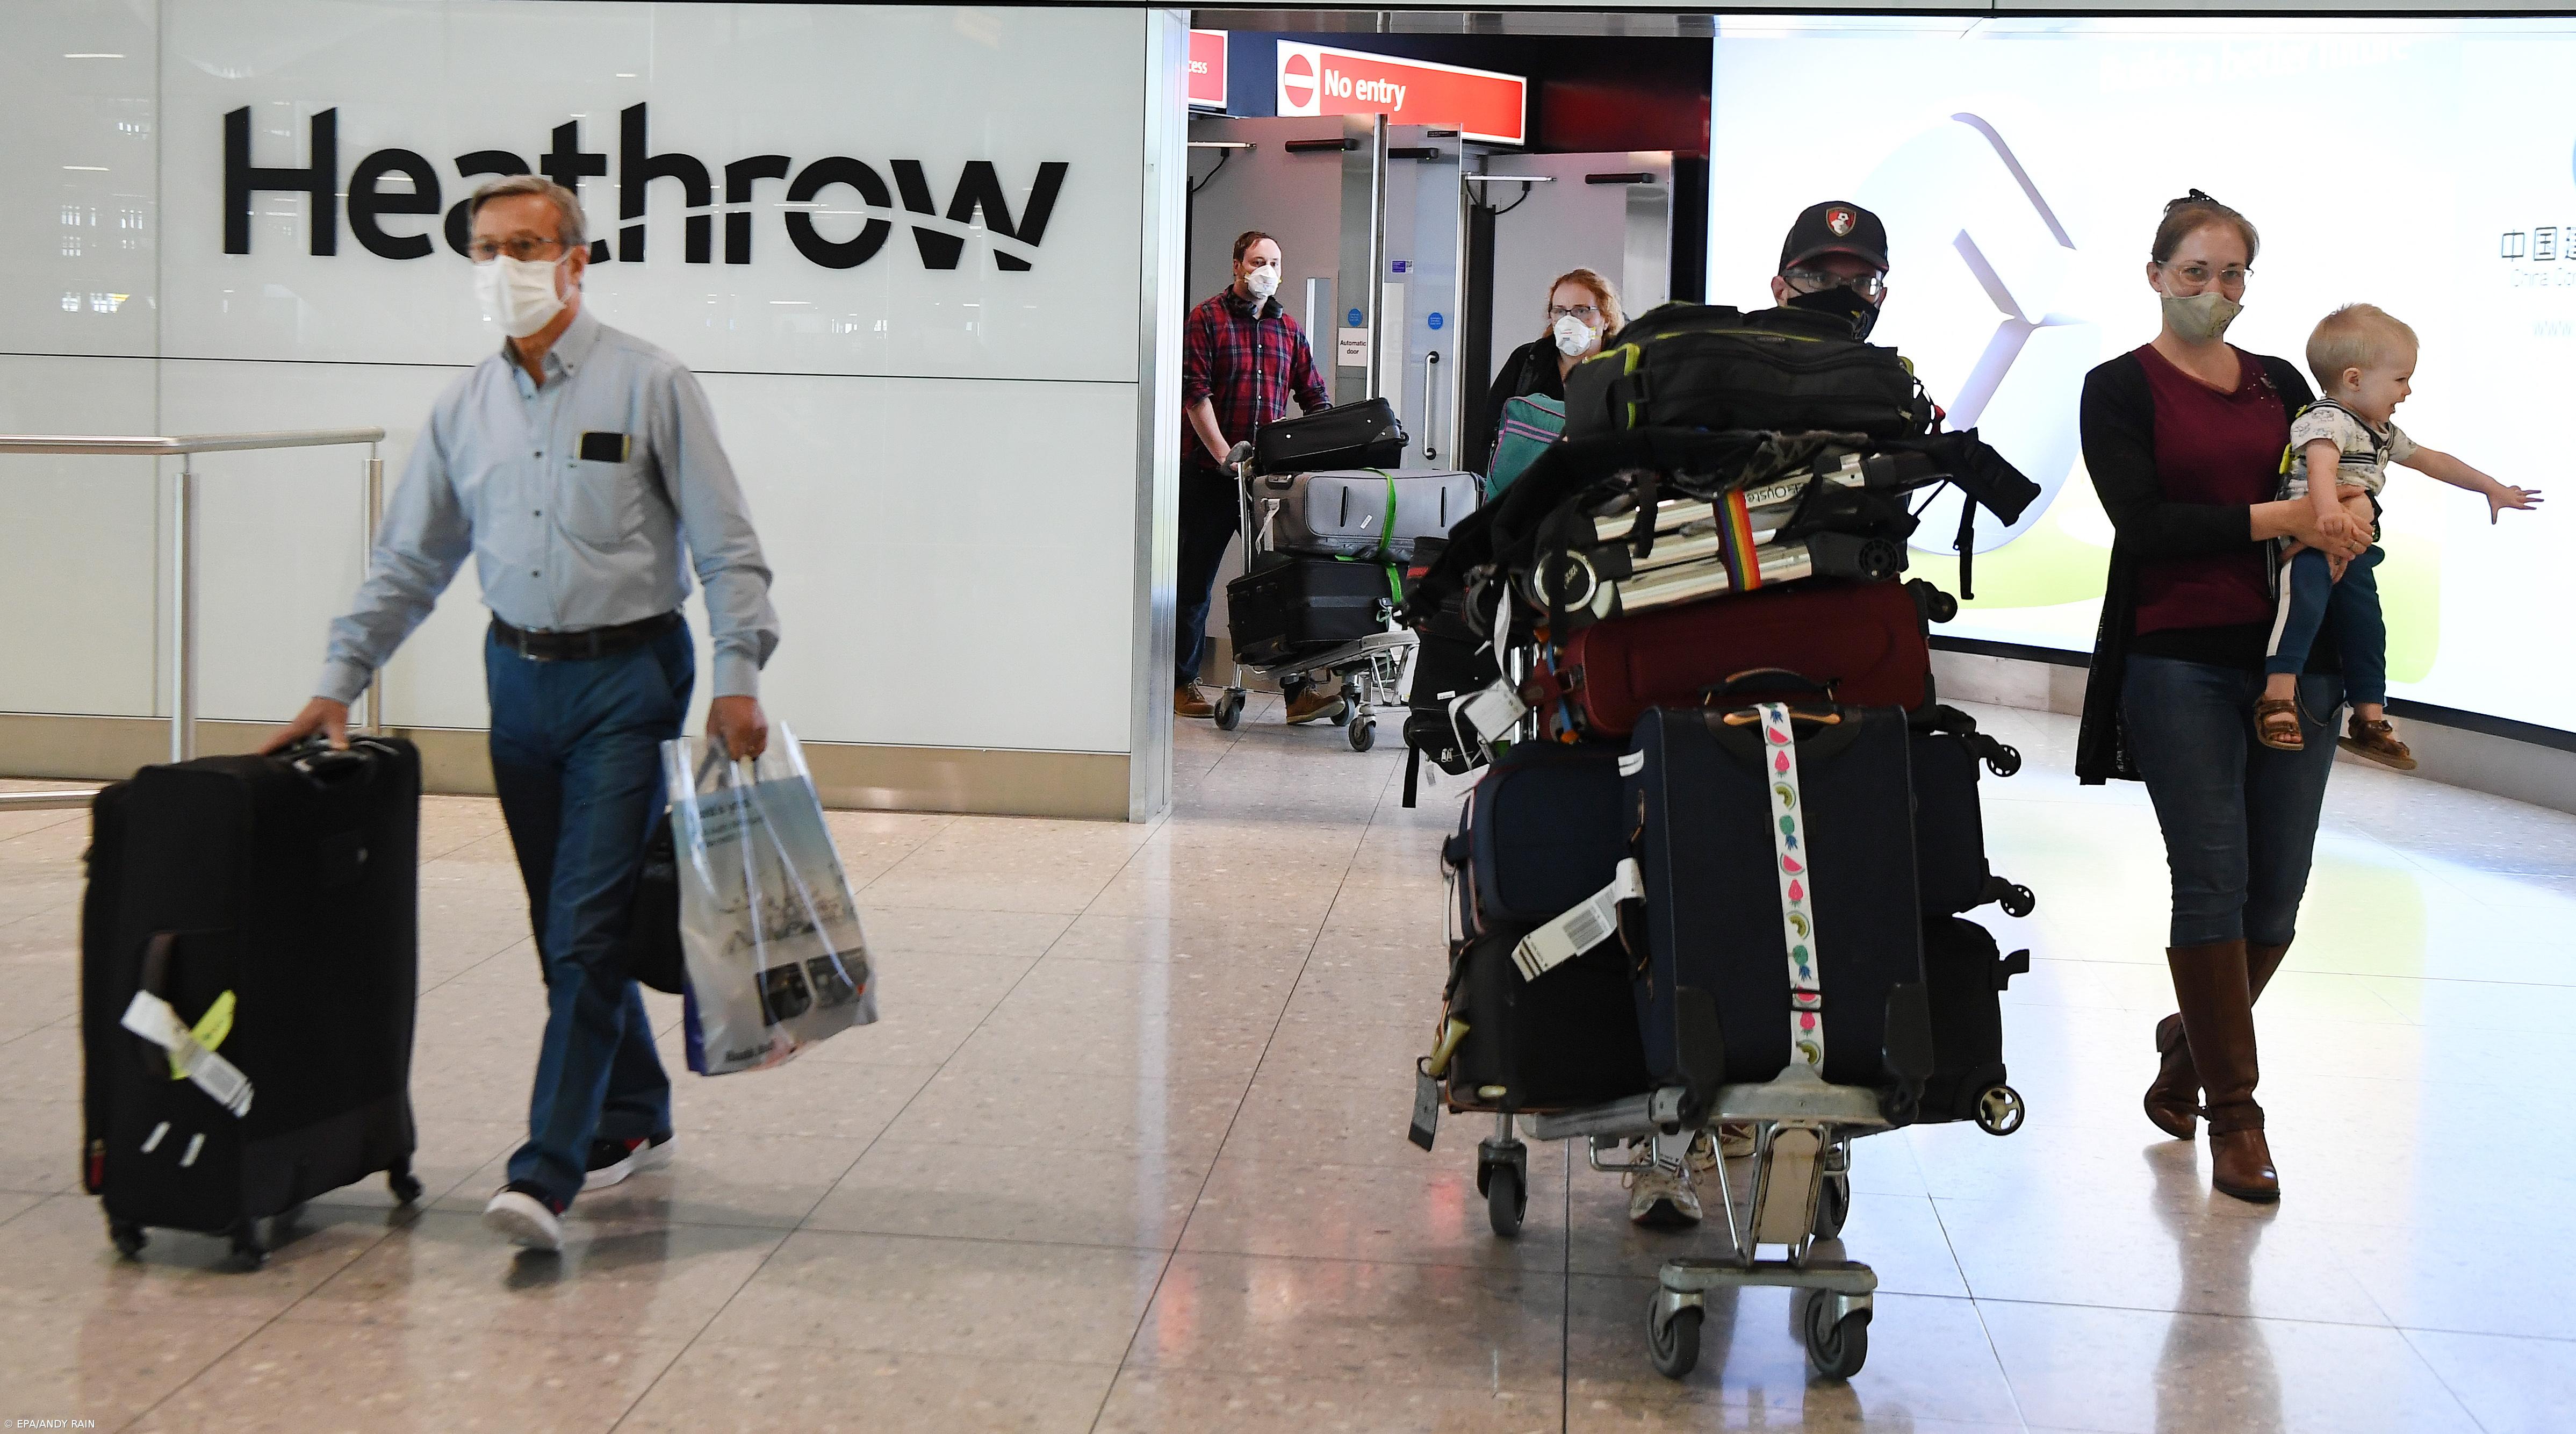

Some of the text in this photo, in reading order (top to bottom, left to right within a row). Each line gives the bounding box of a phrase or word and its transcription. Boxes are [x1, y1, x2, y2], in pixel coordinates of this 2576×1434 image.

[1325, 69, 1407, 112] No entry
[224, 102, 1069, 271] Heathrow
